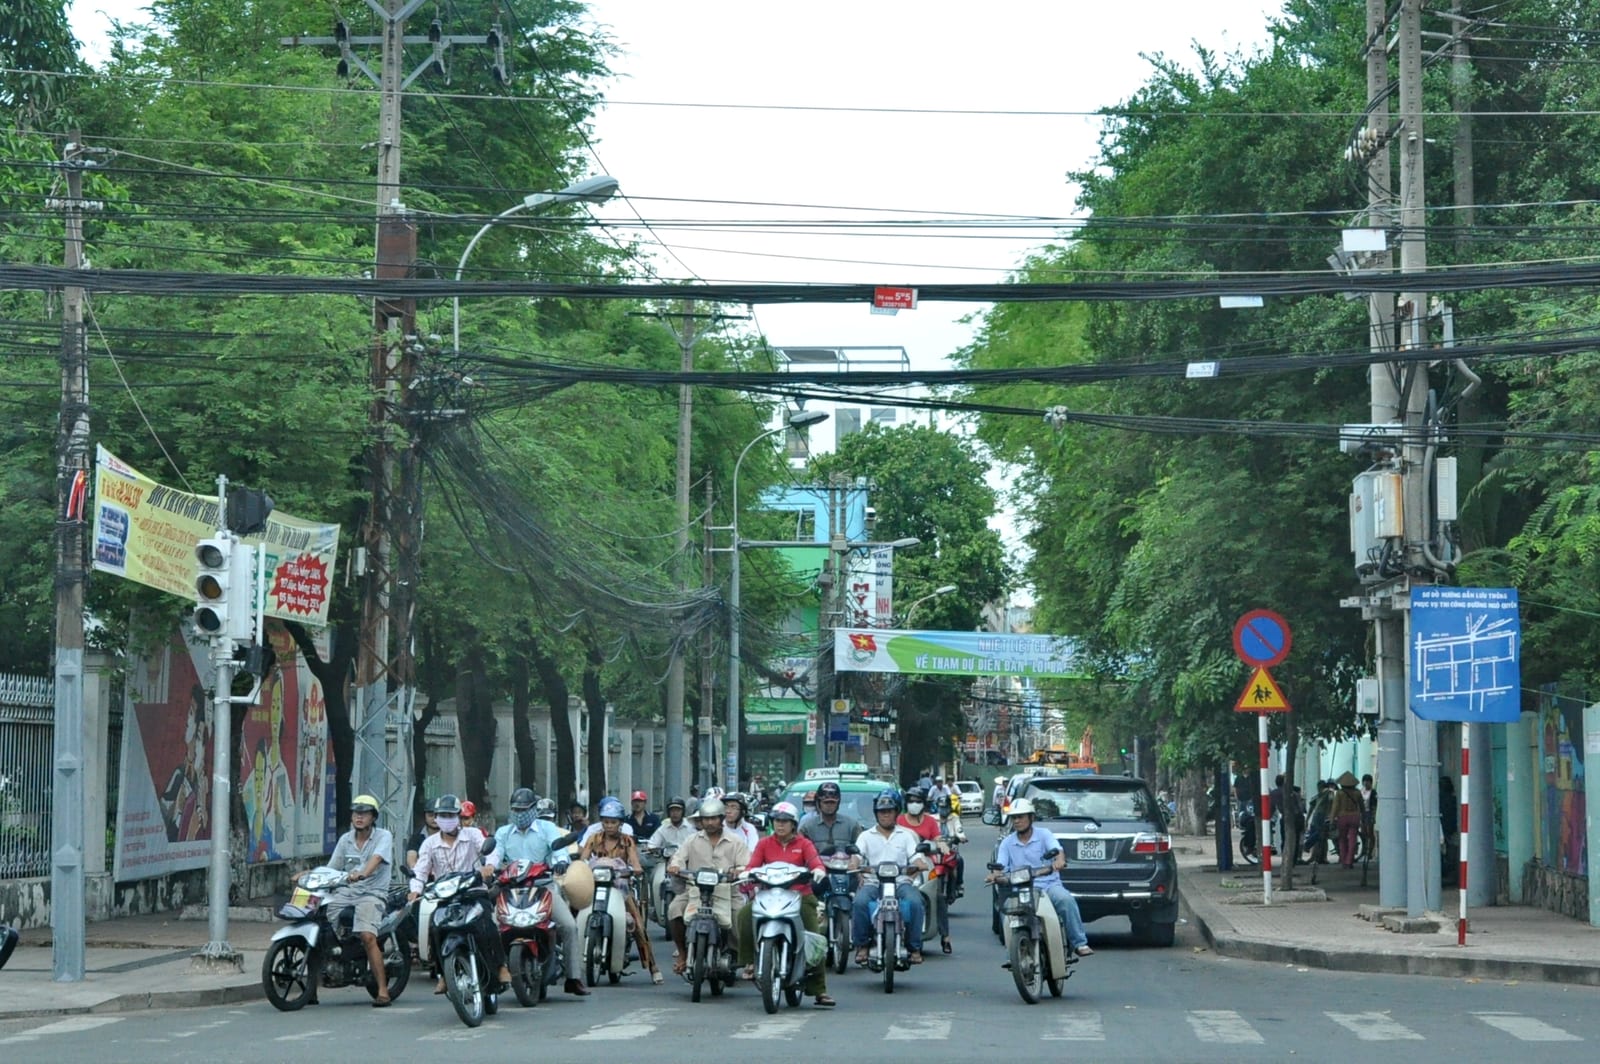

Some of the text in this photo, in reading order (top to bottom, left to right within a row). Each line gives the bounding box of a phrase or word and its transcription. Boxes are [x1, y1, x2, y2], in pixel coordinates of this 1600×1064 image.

[932, 656, 959, 670] THAM
[1083, 840, 1099, 850] 56P
[1080, 850, 1103, 858] 9040
